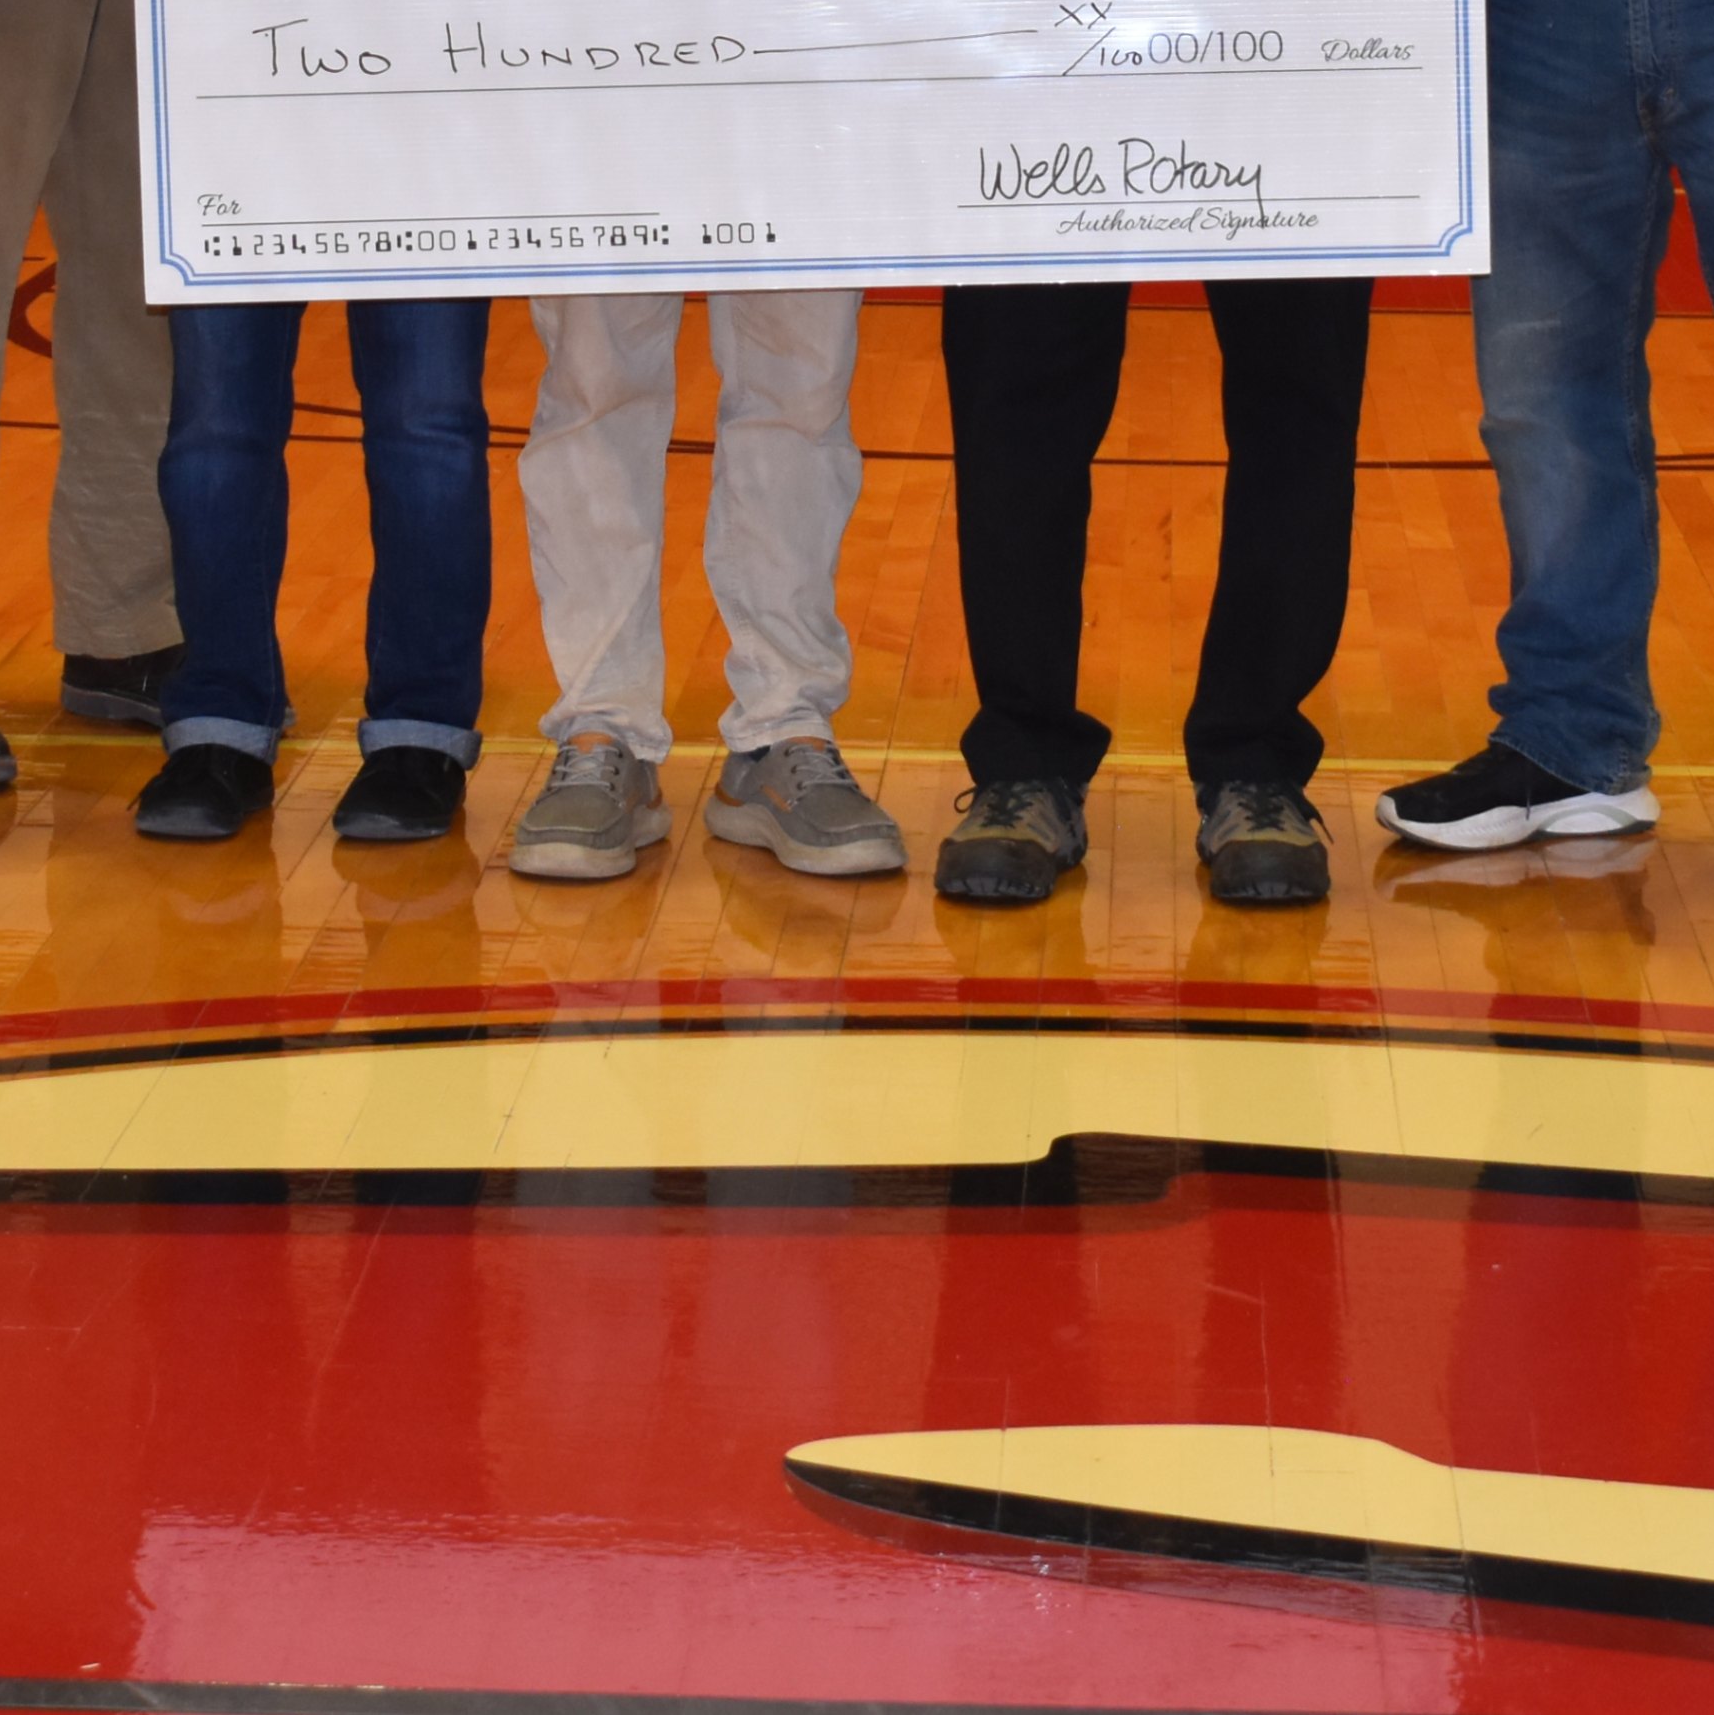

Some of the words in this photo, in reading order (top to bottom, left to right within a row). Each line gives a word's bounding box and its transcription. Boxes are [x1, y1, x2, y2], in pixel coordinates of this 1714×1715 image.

[1148, 30, 1283, 64] 00/100
[1321, 39, 1415, 63] Dollars
[980, 143, 1107, 200] Wells
[1119, 138, 1265, 229] Rotary
[198, 194, 242, 218] For
[1055, 209, 1196, 236] Authorized
[1199, 207, 1319, 241] Signature
